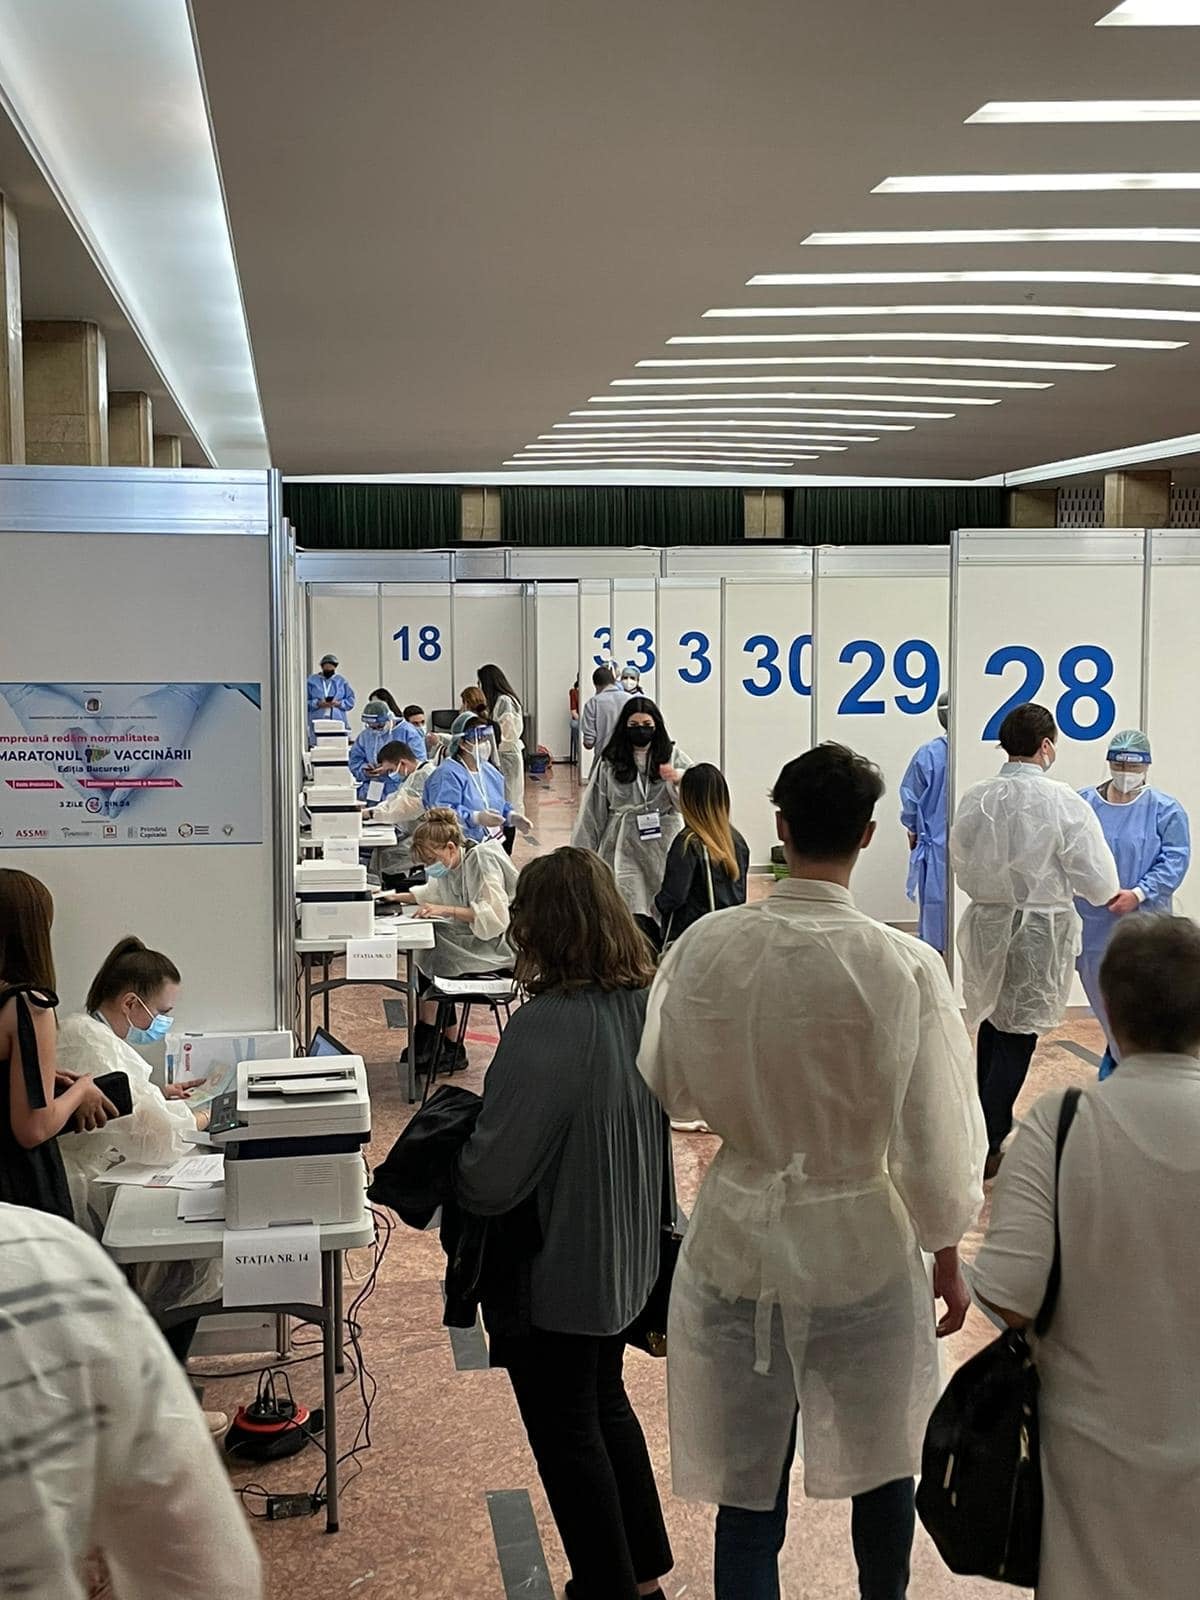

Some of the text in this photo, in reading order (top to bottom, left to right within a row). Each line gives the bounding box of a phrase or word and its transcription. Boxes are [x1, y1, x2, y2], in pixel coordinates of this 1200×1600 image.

[393, 625, 441, 661] 18
[678, 631, 711, 684] 3
[742, 634, 812, 696] 30
[838, 639, 940, 715] 29
[981, 645, 1116, 742] 28
[0, 747, 191, 761] MARATONUL VACCINĂRII
[298, 1253, 308, 1262] 14
